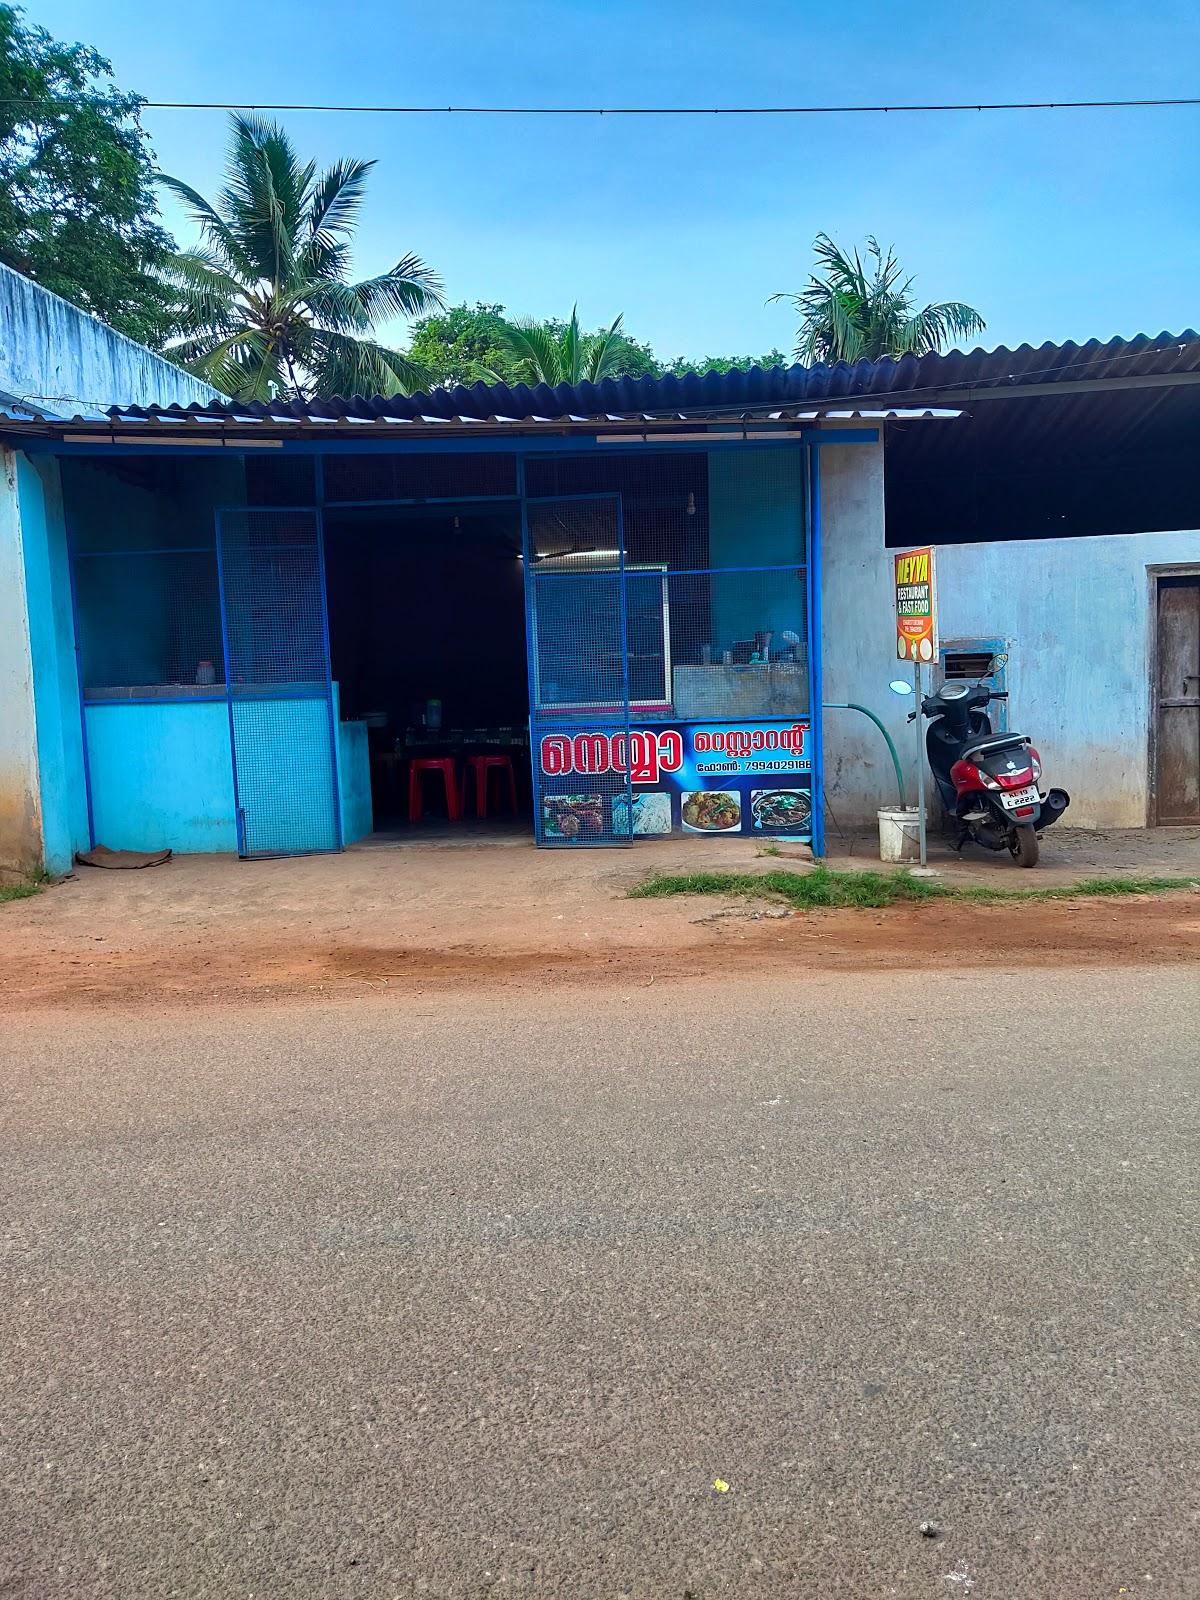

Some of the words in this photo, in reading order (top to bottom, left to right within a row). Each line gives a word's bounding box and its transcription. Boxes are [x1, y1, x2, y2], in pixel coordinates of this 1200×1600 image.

[897, 554, 928, 584] NEYYA
[903, 601, 913, 613] FAST
[914, 600, 928, 613] FOOD
[1014, 795, 1035, 805] 2222
